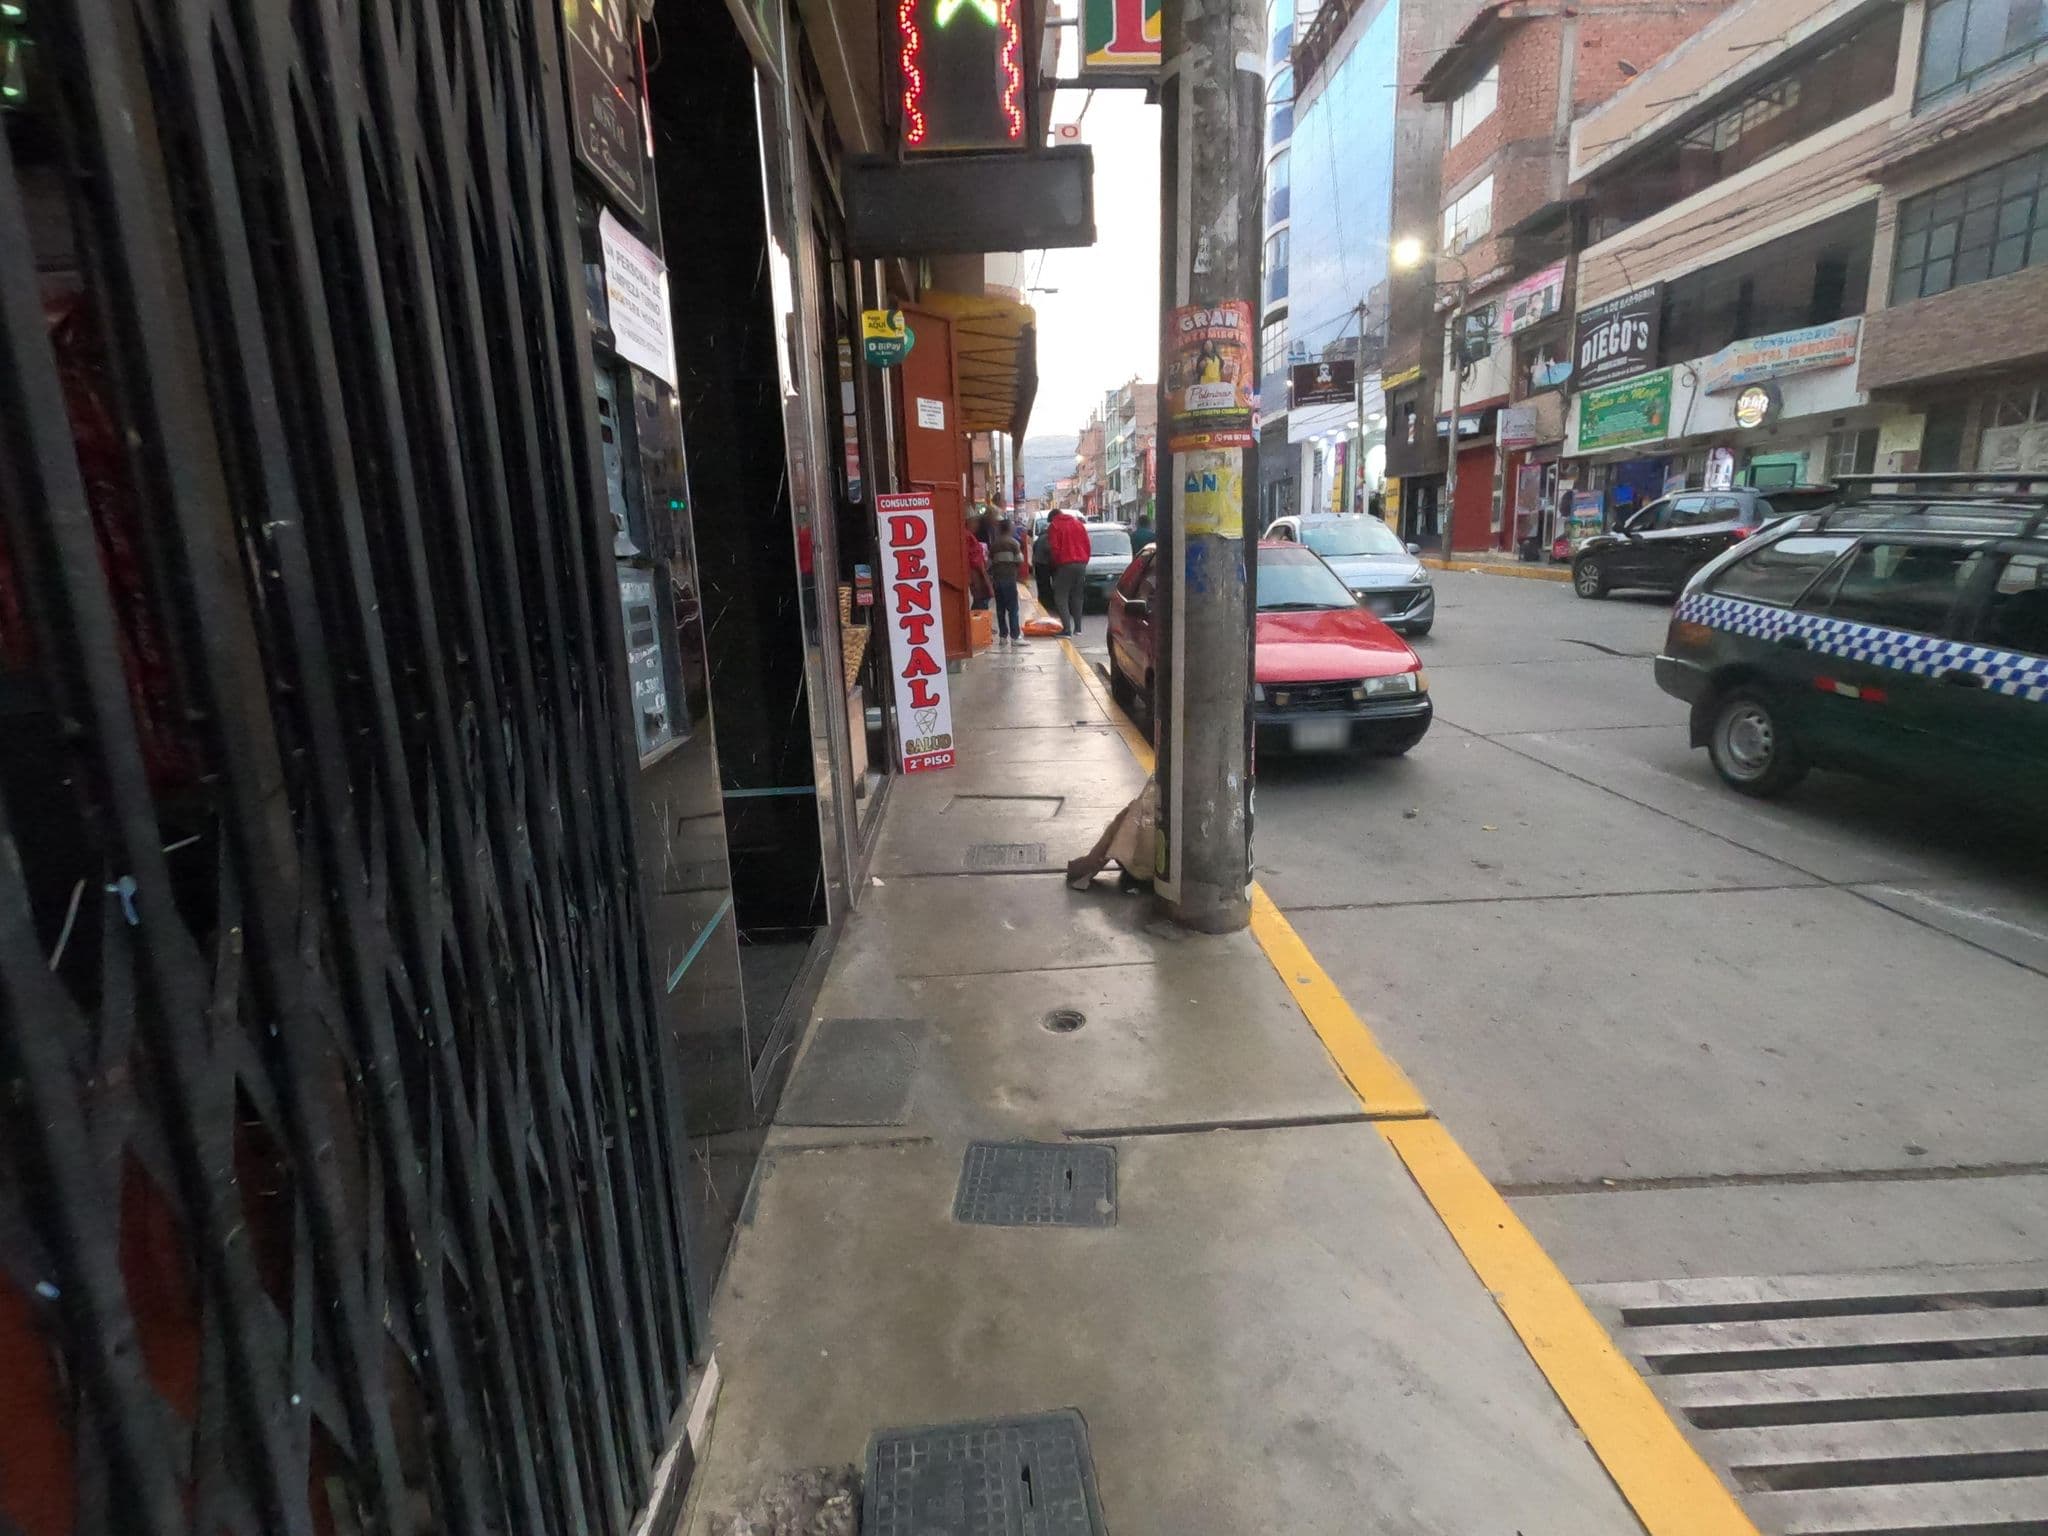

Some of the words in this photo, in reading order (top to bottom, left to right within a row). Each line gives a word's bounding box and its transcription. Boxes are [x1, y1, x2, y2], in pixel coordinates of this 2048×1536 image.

[1180, 309, 1239, 332] GRAN
[878, 342, 901, 351] BiPay
[1581, 320, 1649, 370] DIEGO'S
[880, 497, 931, 509] CONSULTORIO
[888, 514, 942, 709] DENTAL
[905, 733, 952, 755] SALUD
[924, 754, 951, 767] PISO
